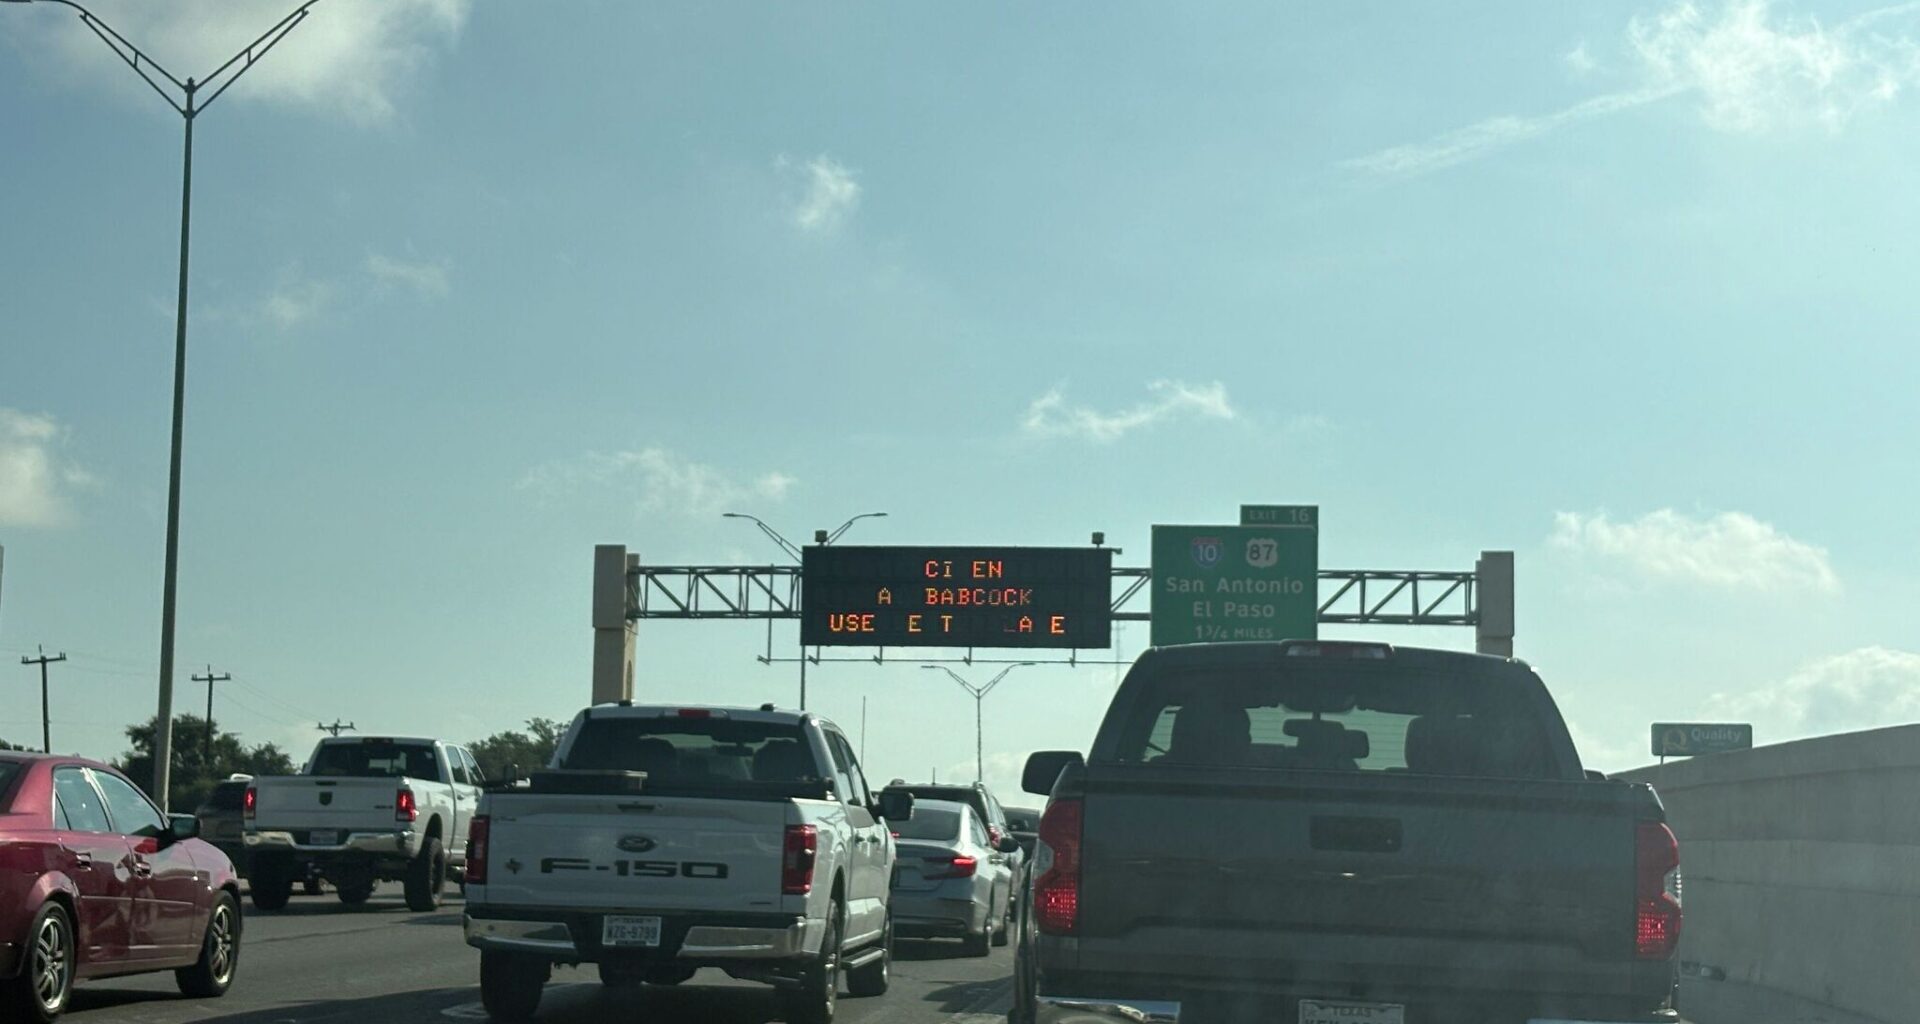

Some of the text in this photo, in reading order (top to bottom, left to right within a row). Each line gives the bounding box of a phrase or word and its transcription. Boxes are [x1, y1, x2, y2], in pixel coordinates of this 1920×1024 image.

[1249, 509, 1309, 522] EXIT 16
[1199, 544, 1275, 562] 10 87
[973, 561, 1002, 578] EN
[1165, 577, 1304, 593] San Antonio
[878, 588, 1032, 605] A BABCOCK
[1193, 602, 1275, 618] El Paso
[830, 614, 875, 632] USE
[1234, 627, 1273, 639] MILES
[1691, 727, 1741, 742] Quality
[541, 858, 729, 879] F-150
